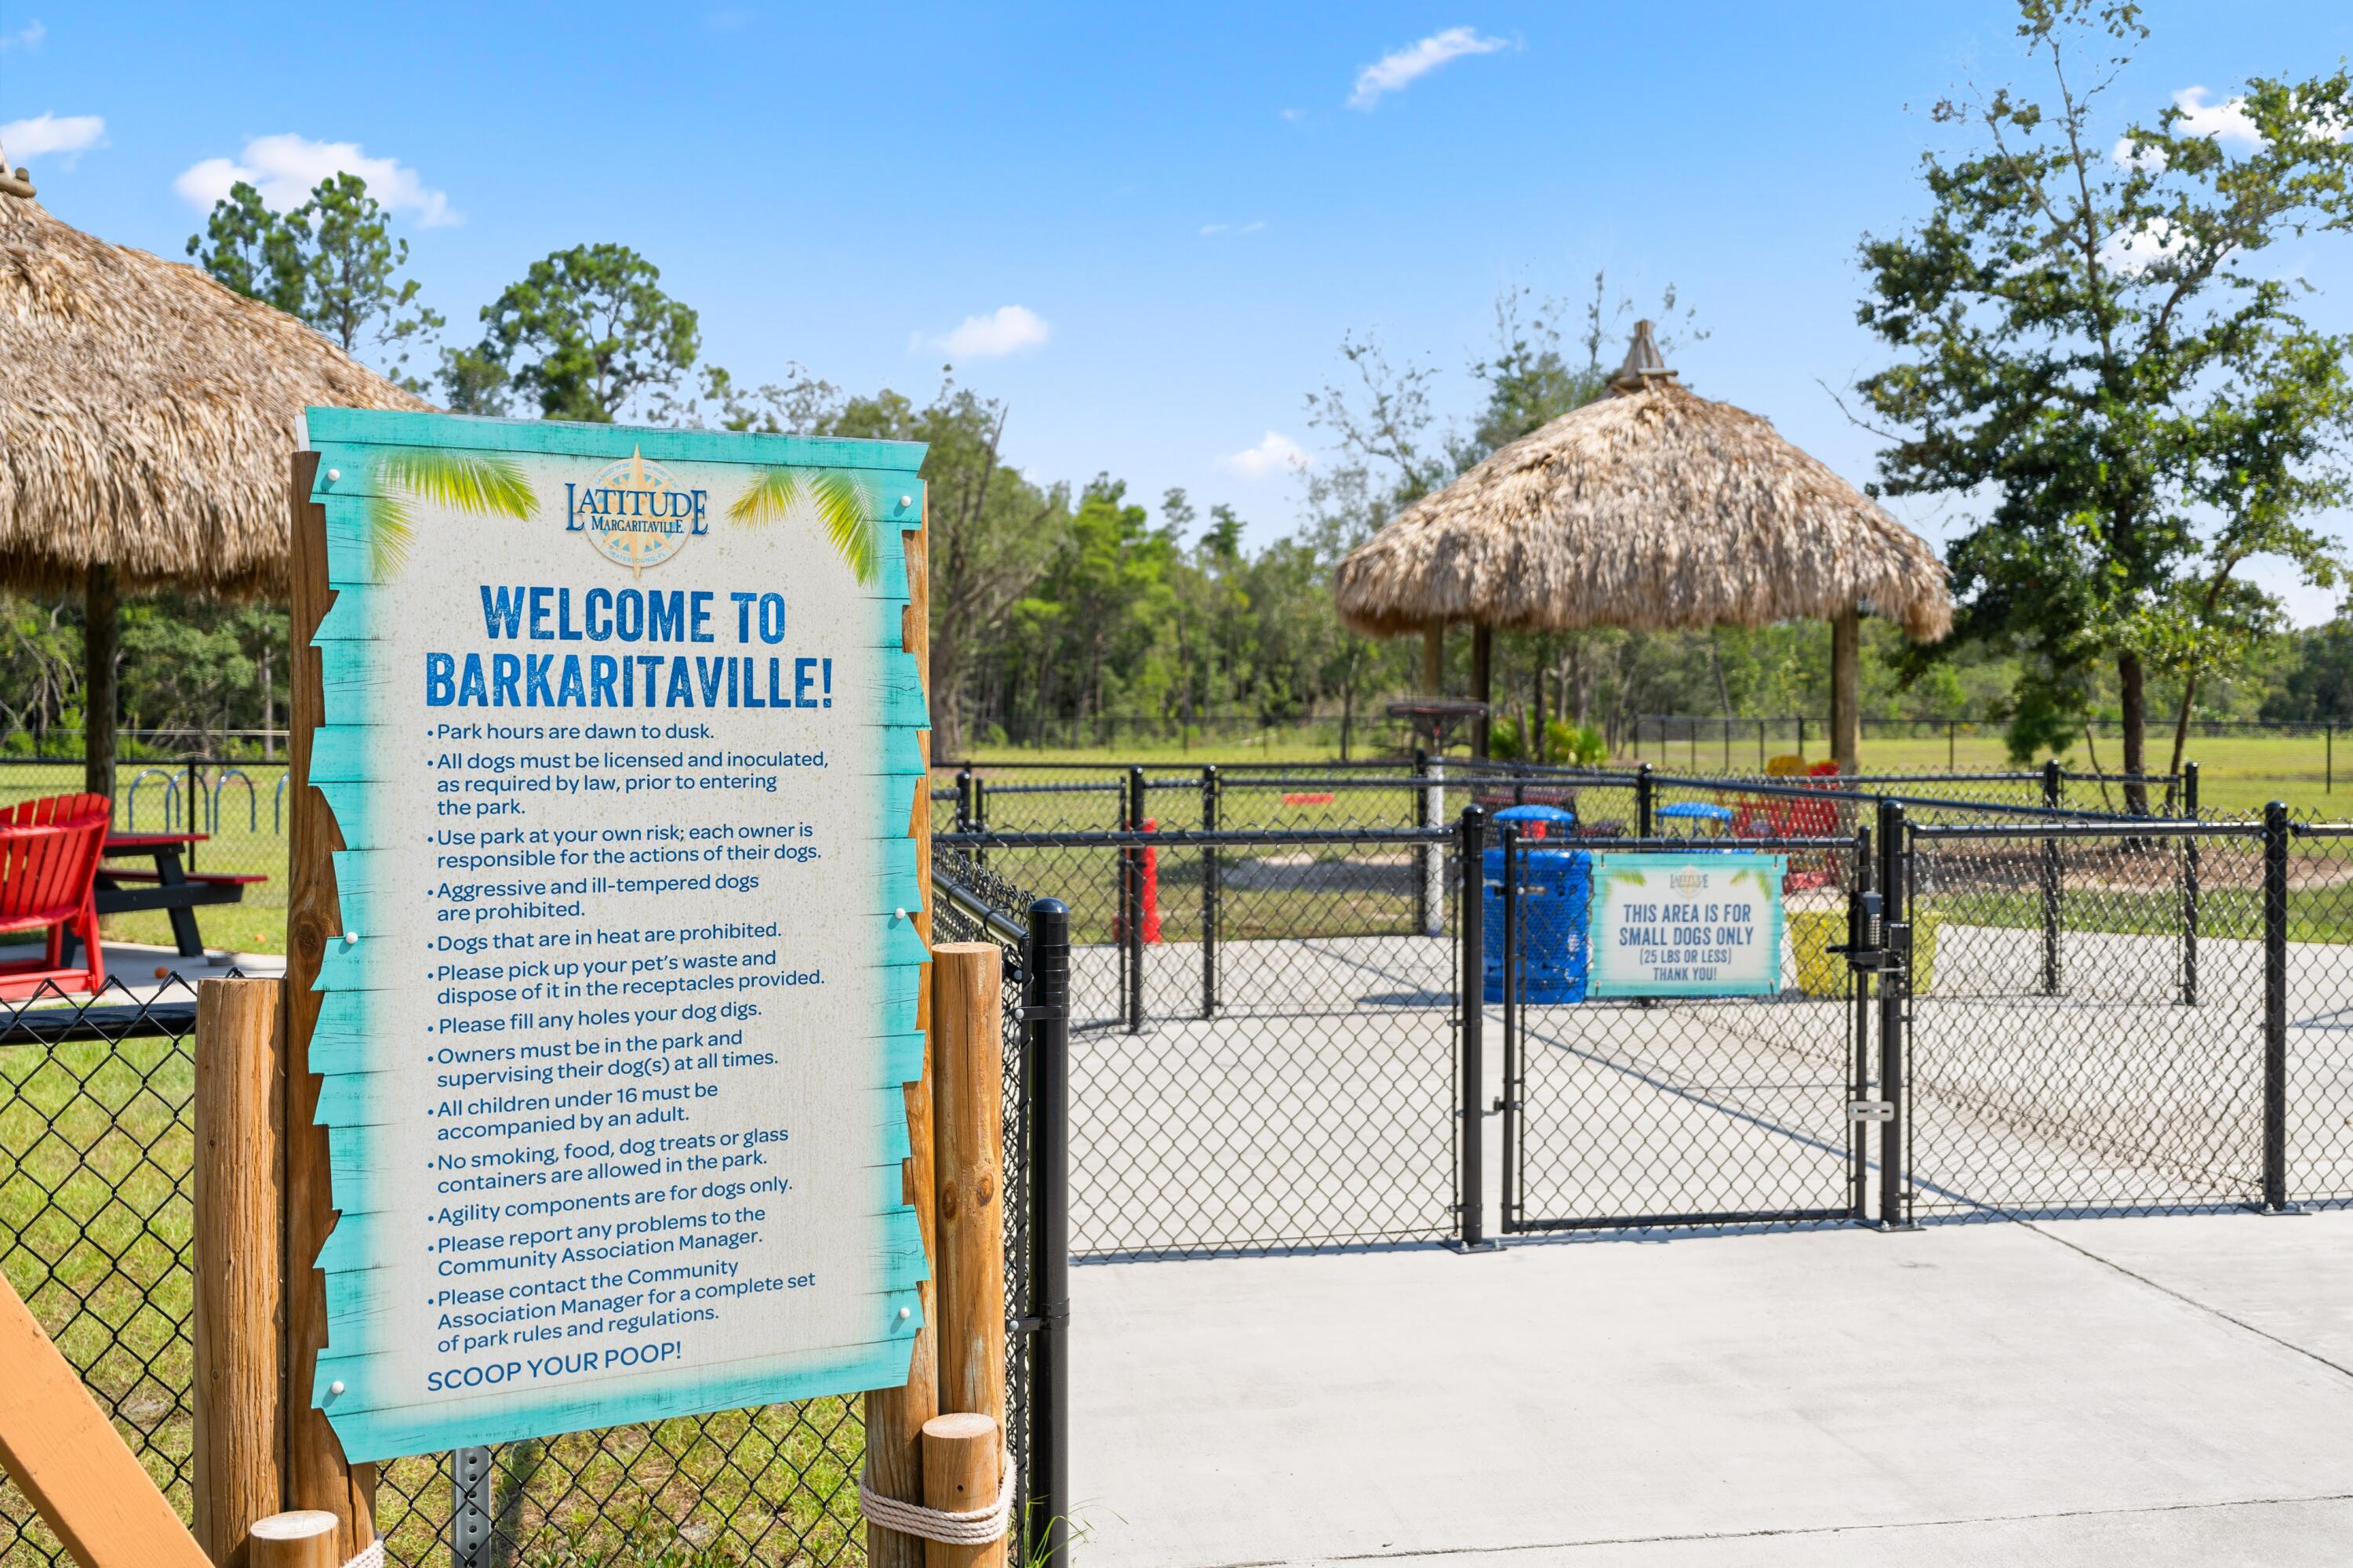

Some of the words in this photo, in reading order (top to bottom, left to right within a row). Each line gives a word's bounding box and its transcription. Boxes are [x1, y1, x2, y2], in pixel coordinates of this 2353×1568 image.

[565, 482, 708, 536] LATITUDE
[591, 515, 684, 533] MARGARITAVILLE
[479, 584, 715, 643] WELCOME
[729, 591, 786, 645] TO
[426, 652, 833, 709] BARKARITAVILLE!
[438, 723, 483, 740] Park
[486, 722, 544, 740] hours
[548, 726, 581, 740] are
[584, 722, 637, 740] dawn
[640, 724, 661, 740] to
[664, 722, 715, 740] dusk.
[436, 752, 462, 769] All
[467, 752, 515, 773] dogs
[520, 754, 571, 769] must
[575, 752, 600, 769] be
[604, 751, 683, 769] licensed
[687, 751, 723, 768] and
[727, 751, 829, 769] inoculated,
[437, 780, 460, 793] as
[464, 774, 551, 796] required
[555, 774, 580, 795] by
[584, 774, 621, 792] law,
[625, 777, 672, 795] prior
[675, 775, 696, 790] to
[699, 774, 777, 793] entering
[436, 799, 471, 816] the
[476, 798, 526, 820] park.
[438, 829, 476, 846] Use
[480, 827, 526, 849] park
[529, 828, 549, 844] at
[553, 829, 598, 847] your
[602, 828, 642, 842] own
[646, 824, 685, 842] risk;
[689, 823, 734, 840] each
[737, 825, 796, 839] owner
[799, 825, 813, 838] is
[437, 849, 556, 872] responsible
[559, 848, 590, 865] for
[592, 848, 625, 864] the
[629, 846, 700, 864] actions
[703, 844, 724, 861] of
[726, 844, 771, 861] their
[773, 843, 820, 863] dogs.
[436, 879, 547, 903] Aggressive
[550, 877, 587, 895] and
[592, 873, 711, 896] ill-tempered
[715, 873, 759, 893] dogs
[437, 908, 471, 922] are
[475, 900, 586, 925] prohibited.
[1624, 904, 1657, 922] THIS
[1661, 904, 1700, 922] AREA
[1704, 904, 1718, 922] IS
[1723, 904, 1751, 922] FOR
[438, 935, 489, 955] Dogs
[492, 932, 535, 949] that
[538, 933, 571, 948] are
[575, 929, 592, 946] in
[597, 928, 641, 945] heat
[644, 929, 676, 943] are
[679, 921, 782, 945] prohibited.
[1619, 926, 1667, 946] SMALL
[1673, 926, 1711, 946] DOGS
[1716, 926, 1754, 945] ONLY
[438, 964, 504, 982] Please
[508, 959, 550, 982] pick
[554, 962, 579, 980] up
[583, 960, 627, 978] your
[682, 953, 738, 970] waste
[741, 949, 776, 966] and
[1639, 948, 1657, 966] (25
[1660, 949, 1680, 963] LBS
[1684, 949, 1698, 963] OR
[1701, 948, 1732, 965] LESS)
[1653, 966, 1689, 980] THANK
[1693, 966, 1717, 980] YOU!
[437, 987, 517, 1007] dispose
[521, 982, 544, 1000] of
[547, 982, 560, 999] it
[564, 981, 581, 998] in
[585, 980, 619, 997] the
[623, 973, 735, 996] receptacles
[738, 969, 824, 992] provided.
[439, 1017, 506, 1035] Please
[509, 1013, 534, 1030] fill
[538, 1015, 574, 1031] any
[578, 1008, 631, 1026] holes
[634, 1008, 678, 1027] your
[681, 1003, 718, 1023] dog
[720, 1001, 761, 1021] digs.
[437, 1047, 516, 1064] Owners
[520, 1041, 571, 1059] must
[576, 1039, 601, 1056] be
[605, 1040, 621, 1054] in
[625, 1035, 658, 1053] the
[662, 1031, 704, 1054] park
[707, 1028, 743, 1047] and
[437, 1064, 554, 1090] supervising
[556, 1060, 604, 1079] their
[607, 1056, 671, 1079] dog(s)
[674, 1055, 694, 1071] at
[696, 1053, 718, 1070] all
[722, 1050, 778, 1068] times.
[437, 1099, 463, 1118] All
[467, 1095, 550, 1115] children
[555, 1090, 613, 1109] under
[616, 1087, 638, 1104] 16
[642, 1084, 691, 1102] must
[694, 1082, 718, 1098] be
[437, 1113, 576, 1141] accompanied
[580, 1112, 604, 1131] by
[608, 1113, 631, 1127] an
[635, 1105, 689, 1125] adult.
[438, 1154, 467, 1171] No
[471, 1146, 559, 1168] smoking,
[564, 1141, 615, 1159] food,
[619, 1137, 656, 1157] dog
[659, 1133, 716, 1151] treats
[719, 1133, 740, 1147] or
[742, 1128, 789, 1148] glass
[437, 1171, 547, 1194] containers
[551, 1169, 584, 1184] are
[587, 1157, 661, 1181] allowed
[666, 1156, 682, 1173] in
[686, 1154, 718, 1171] the
[722, 1149, 767, 1172] park.
[437, 1204, 500, 1227] Agility
[504, 1191, 631, 1217] components
[635, 1190, 666, 1205] are
[669, 1184, 697, 1201] for
[701, 1181, 746, 1200] dogs
[749, 1175, 791, 1194] only.
[438, 1235, 504, 1254] Please
[509, 1226, 573, 1249] report
[576, 1224, 613, 1241] any
[616, 1214, 707, 1239] problems
[711, 1211, 731, 1226] to
[734, 1207, 766, 1224] the
[438, 1250, 558, 1277] Community
[561, 1238, 675, 1264] Association
[678, 1231, 763, 1251] Manager.
[437, 1302, 556, 1330] Association
[561, 1293, 645, 1315] Manager
[647, 1288, 677, 1305] for
[679, 1289, 691, 1301] a
[694, 1277, 784, 1300] complete
[787, 1272, 816, 1289] set
[438, 1287, 505, 1308] Please
[508, 1276, 587, 1299] contact
[590, 1271, 624, 1290] the
[627, 1259, 739, 1285] Community
[437, 1334, 460, 1353] of
[464, 1329, 508, 1355] park
[513, 1325, 562, 1344] rules
[566, 1317, 603, 1337] and
[608, 1308, 719, 1334] regulations.
[427, 1361, 522, 1392] SCOOP
[526, 1352, 598, 1378] YOUR
[605, 1341, 682, 1369] POOP!
